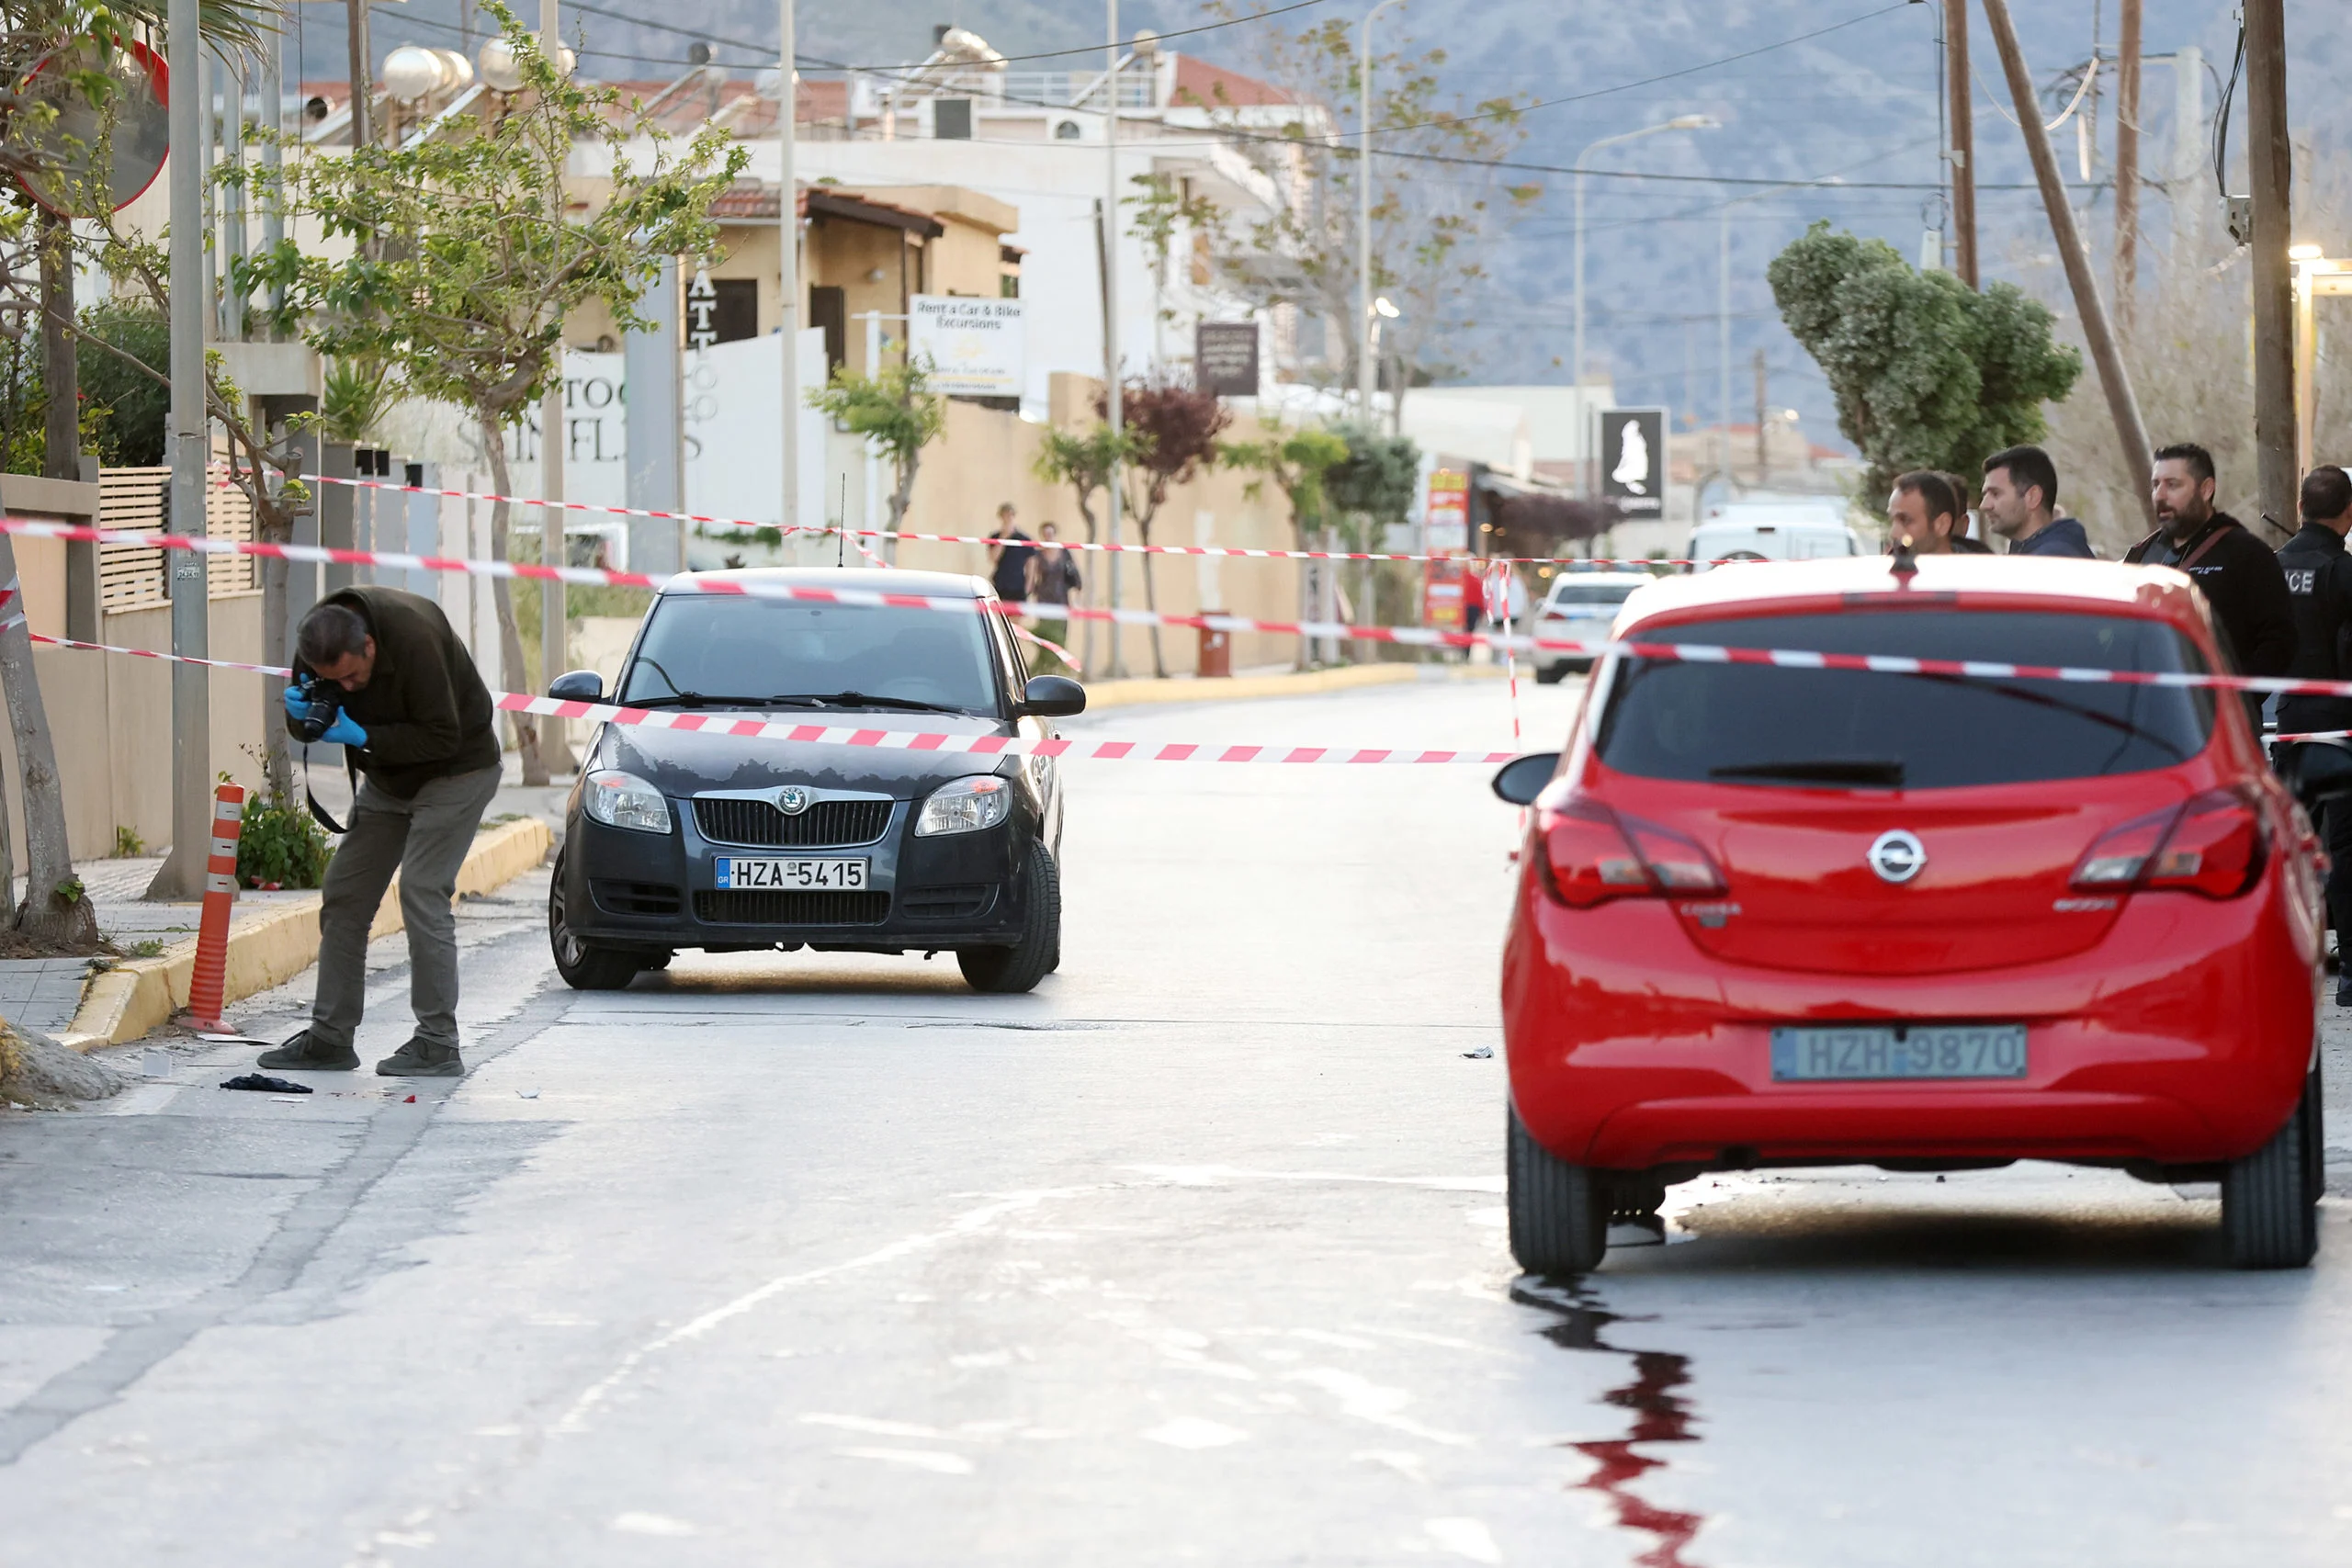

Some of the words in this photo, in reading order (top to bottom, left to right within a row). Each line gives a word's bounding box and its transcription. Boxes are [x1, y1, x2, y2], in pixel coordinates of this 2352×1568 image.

[917, 301, 946, 314] Rent
[958, 303, 980, 316] Car
[995, 305, 1022, 317] Bike
[936, 316, 1001, 330] Excursions
[718, 874, 729, 884] GR
